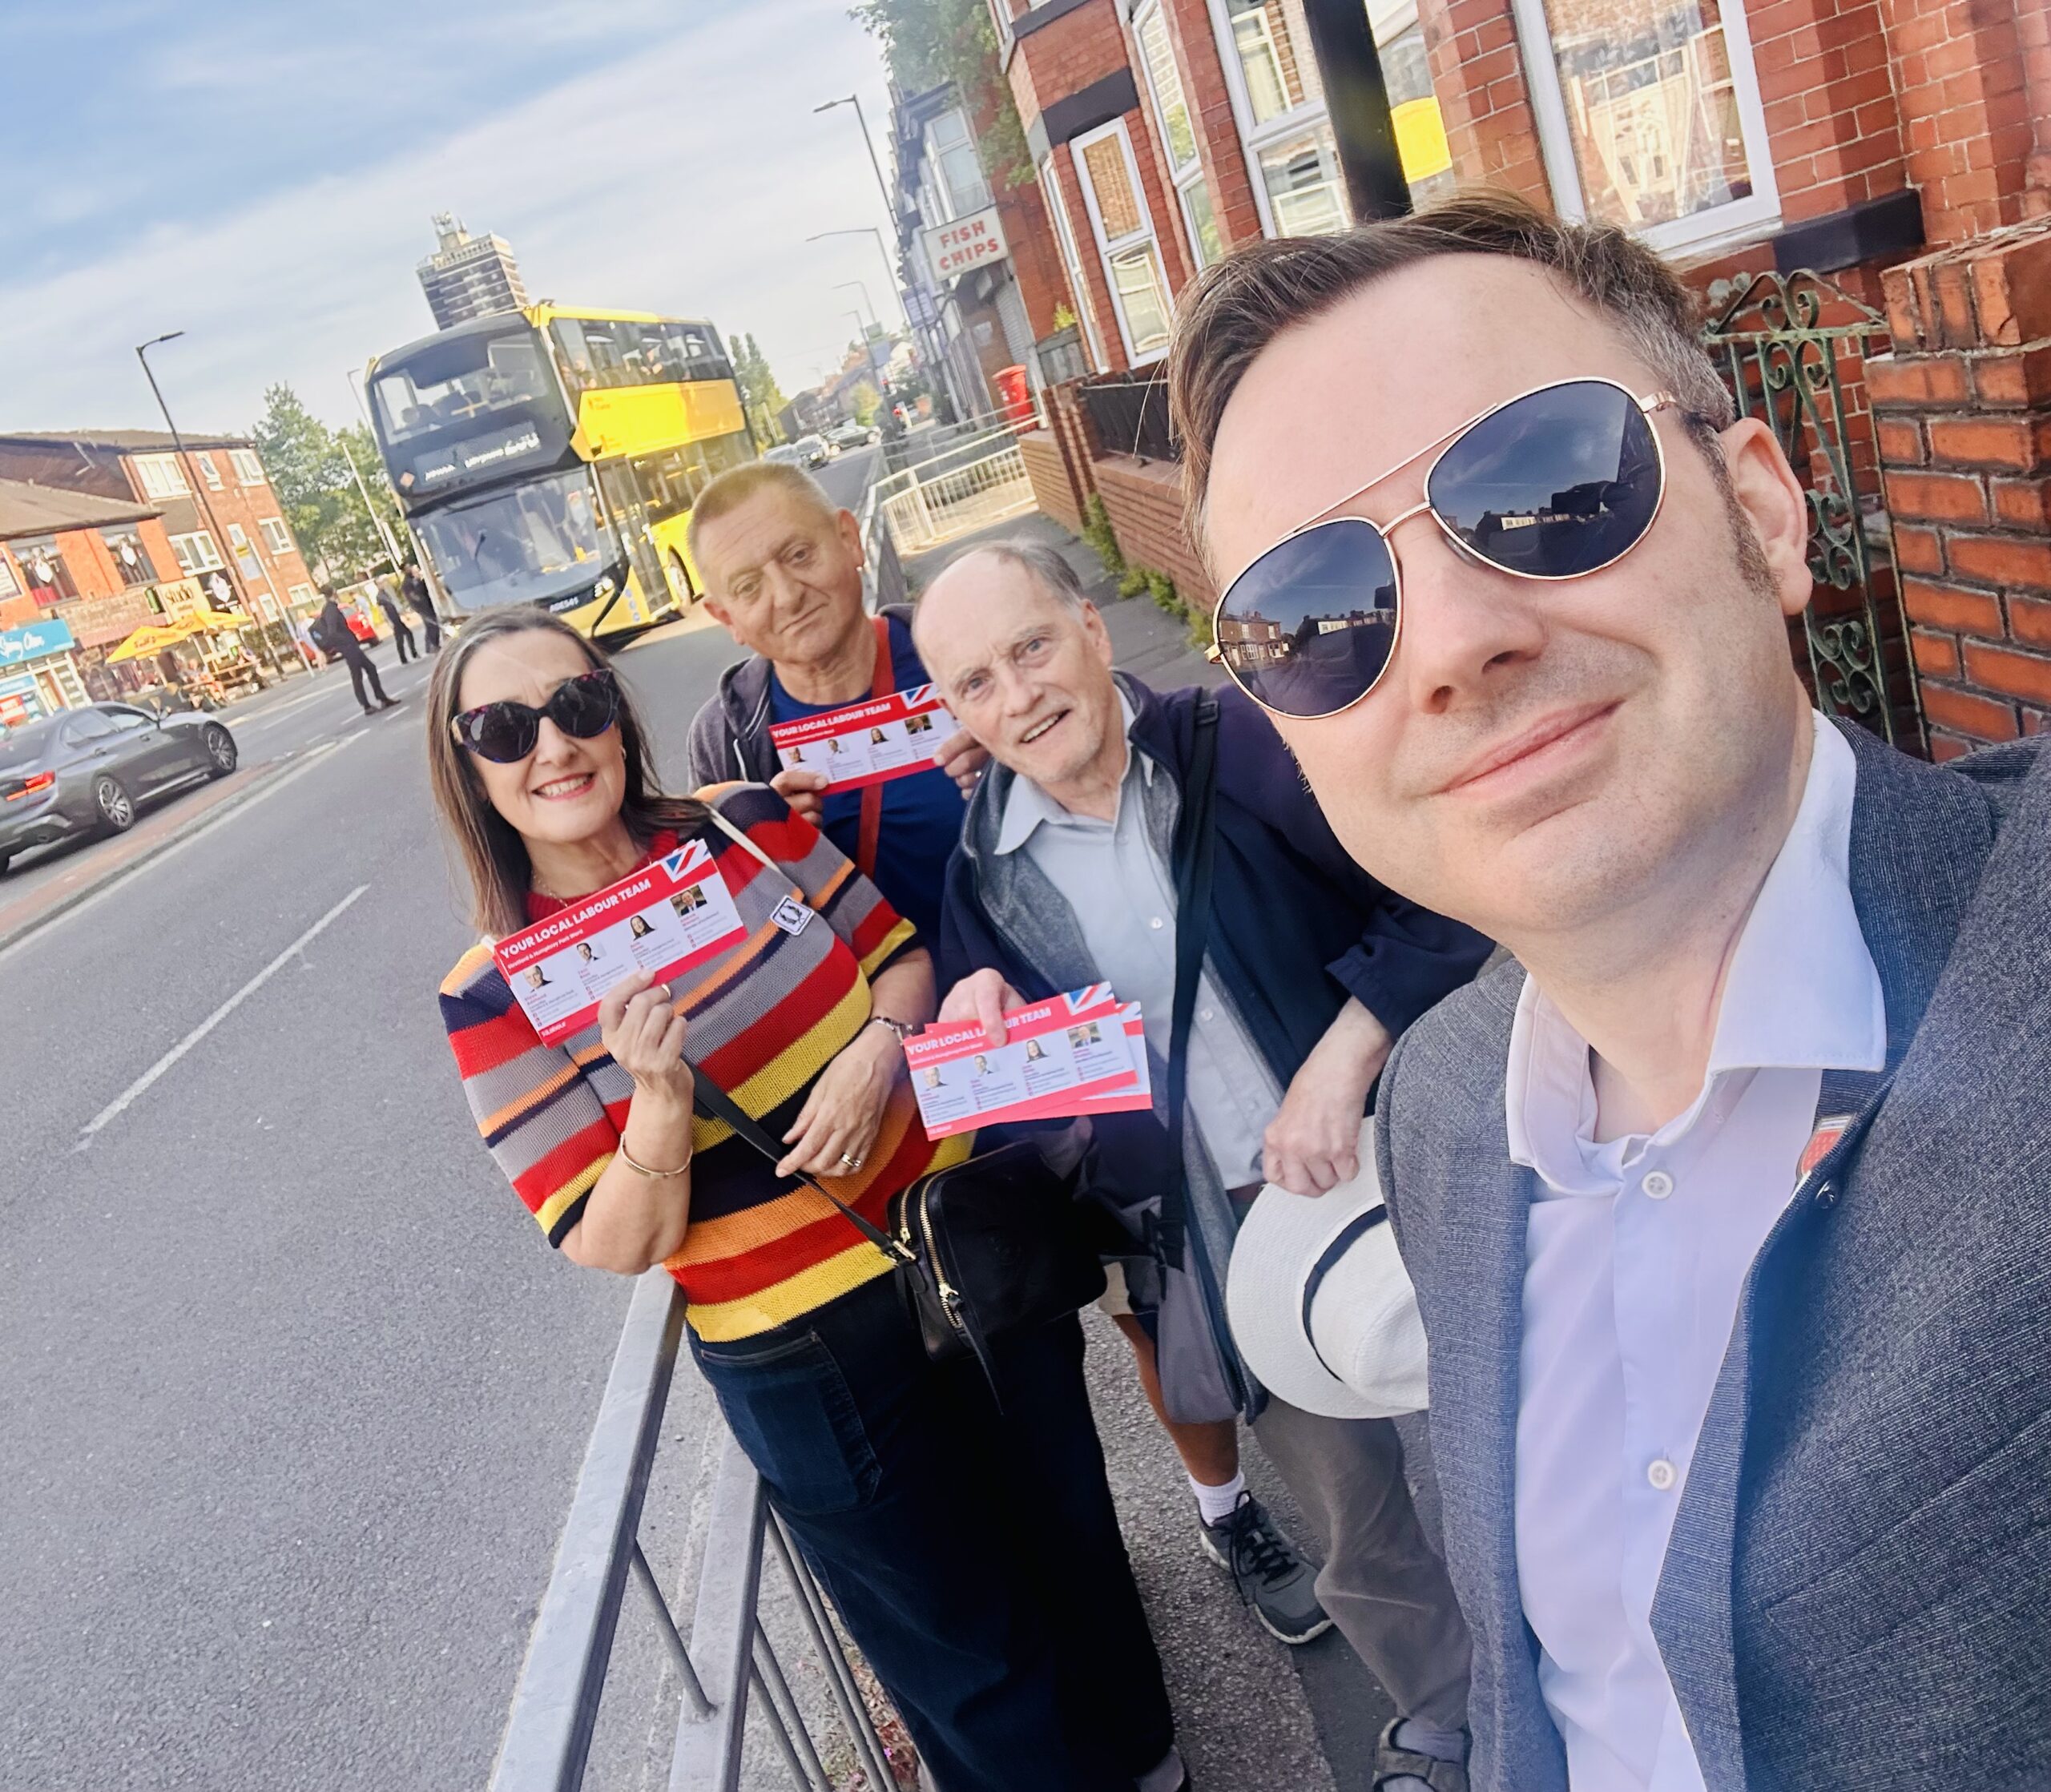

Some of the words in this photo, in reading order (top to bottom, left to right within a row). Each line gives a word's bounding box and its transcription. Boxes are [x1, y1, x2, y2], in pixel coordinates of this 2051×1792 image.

[940, 220, 985, 248] FISH
[940, 239, 998, 270] CHIPS
[772, 724, 798, 738] YOUR
[798, 719, 828, 734] LOCAL
[827, 710, 865, 726] LABOUR
[864, 703, 891, 717] TEAM
[500, 935, 536, 959] YOUR
[534, 918, 574, 944] LOCAL
[572, 895, 619, 924] LABOUR
[618, 878, 652, 902] TEAM
[906, 1042, 940, 1055] YOUR
[938, 1030, 977, 1048] LOCAL
[1019, 1007, 1051, 1025] TEAM
